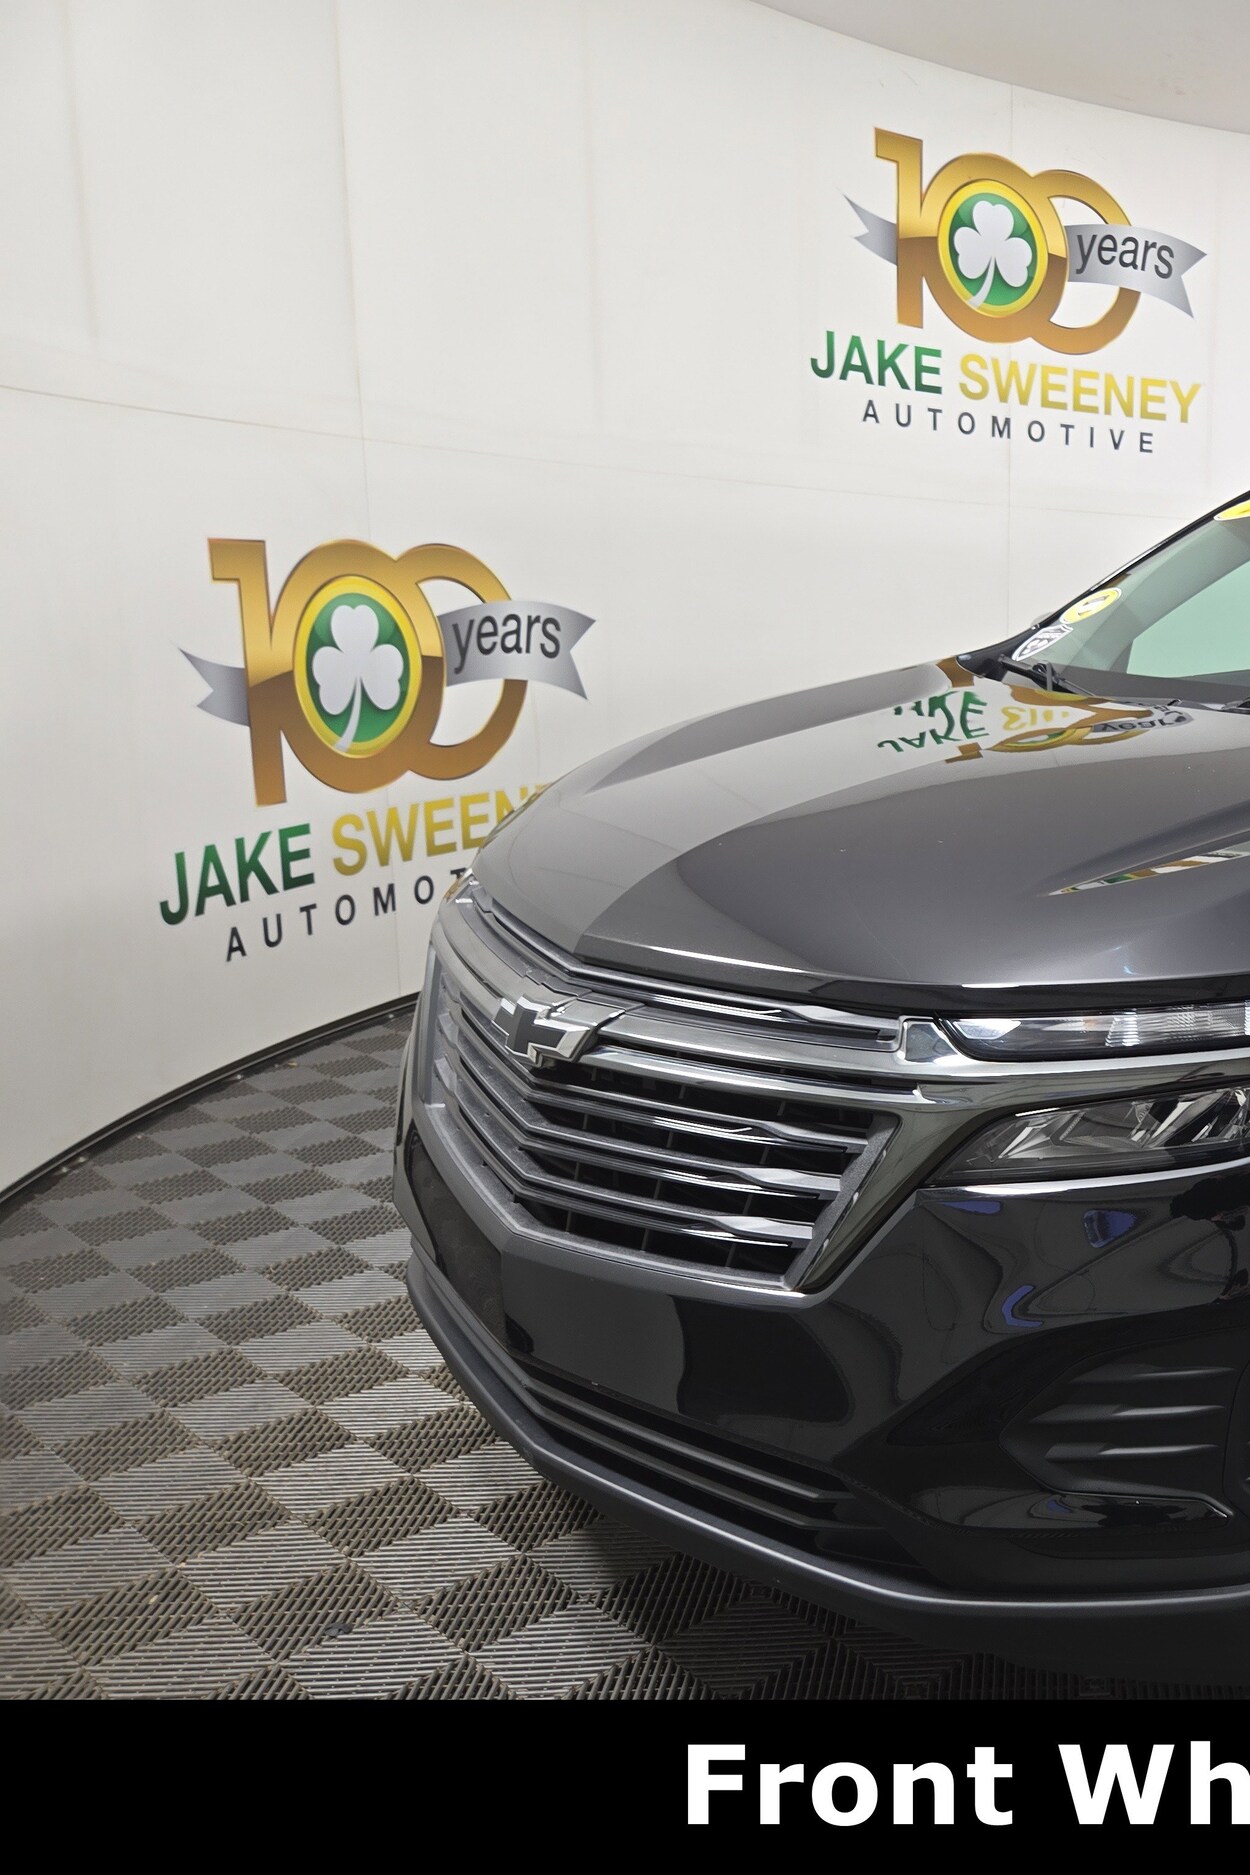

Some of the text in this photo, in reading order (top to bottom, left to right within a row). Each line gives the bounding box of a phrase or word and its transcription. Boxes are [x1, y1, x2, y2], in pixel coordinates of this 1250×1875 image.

[874, 127, 1141, 355] 100
[1075, 232, 1175, 279] years
[810, 330, 1202, 424] JAKE SWEENEY
[862, 399, 1154, 454] AUTOMOTIVE
[207, 537, 528, 807] 100
[452, 613, 562, 675] years
[160, 823, 315, 926] JAKE
